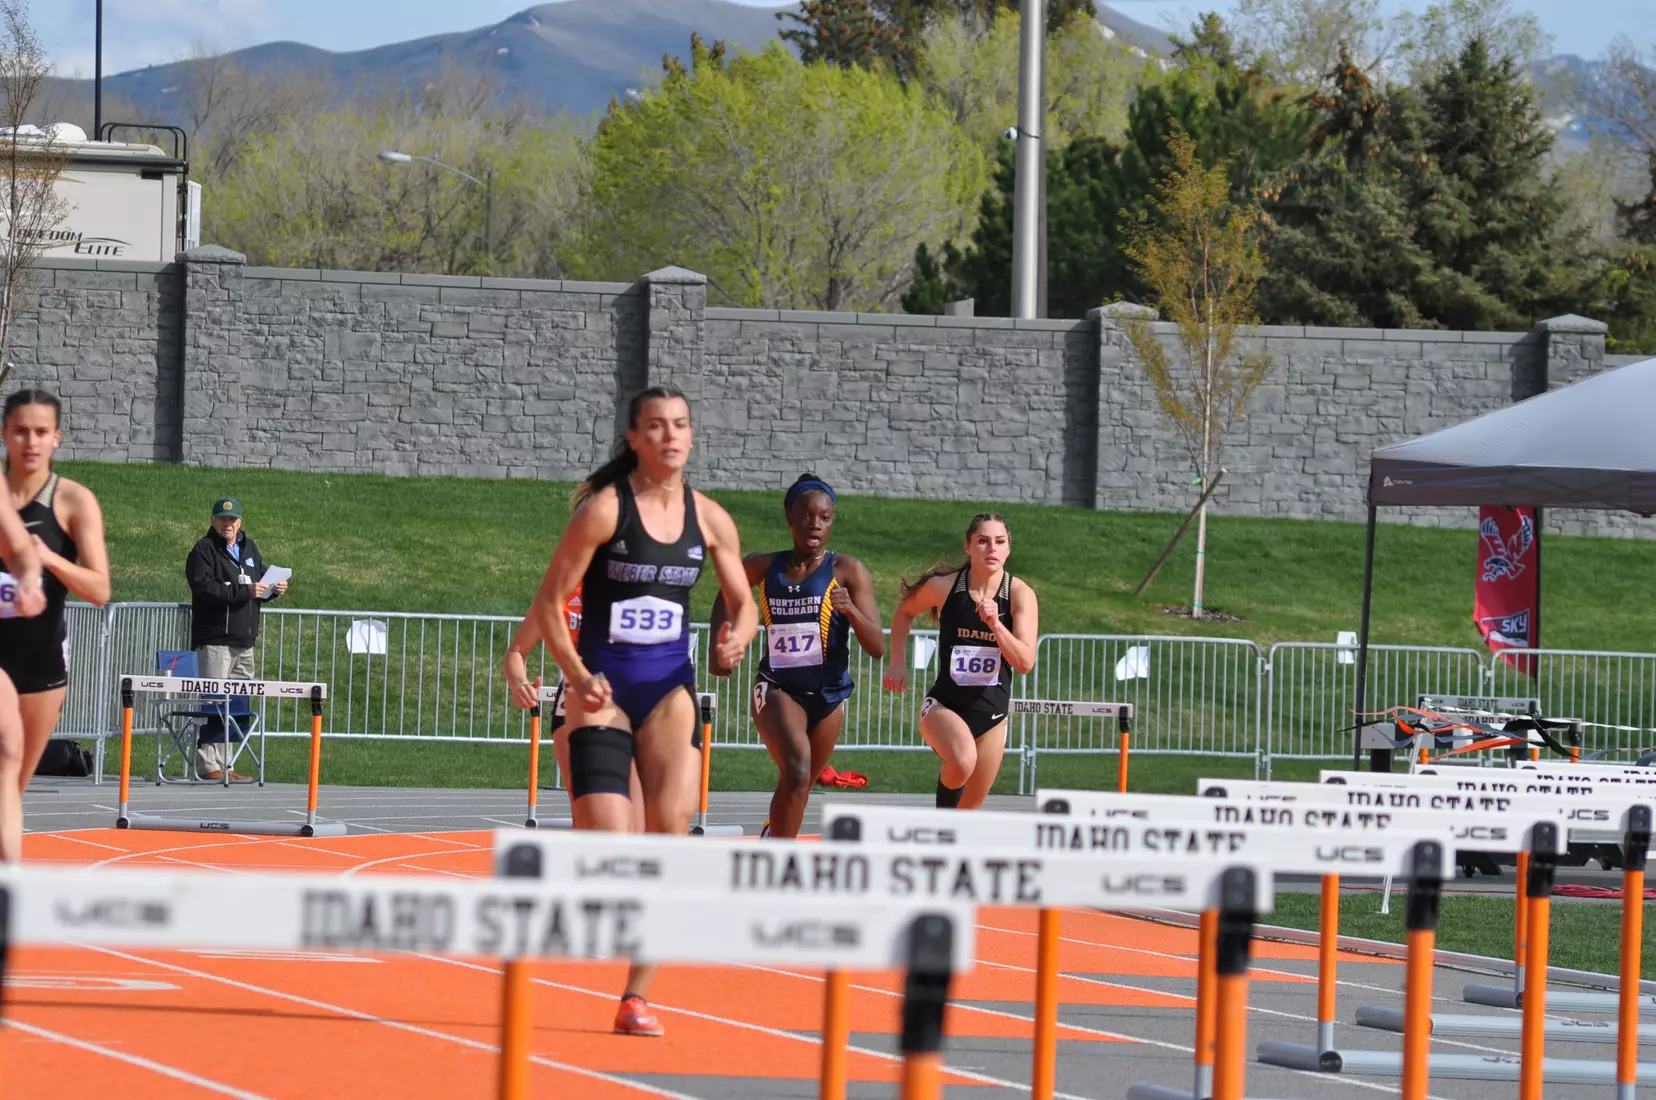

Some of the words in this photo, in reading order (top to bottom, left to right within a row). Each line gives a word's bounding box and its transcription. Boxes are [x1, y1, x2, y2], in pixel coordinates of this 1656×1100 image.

[74, 241, 125, 256] ELITE
[607, 559, 657, 582] WEBER
[768, 596, 822, 607] NORTHERN
[771, 605, 819, 616] COLORADO
[620, 609, 674, 630] 533
[1502, 614, 1528, 633] SKY
[774, 635, 815, 653] 417
[955, 657, 996, 673] 168
[181, 680, 219, 693] IDAHO
[223, 682, 265, 695] STATE
[1014, 701, 1041, 713] IDAHO
[1044, 703, 1074, 715] STATE
[200, 821, 229, 829] UCS
[888, 827, 957, 844] UCS
[1035, 823, 1130, 851] IDAHO
[1143, 828, 1247, 853] STATE
[1315, 846, 1385, 863] UCS
[731, 851, 870, 892] IDAHO
[890, 857, 1044, 903] STATE
[1101, 873, 1187, 895] UCS
[301, 889, 456, 948] IDAHO
[473, 895, 645, 956] STATE
